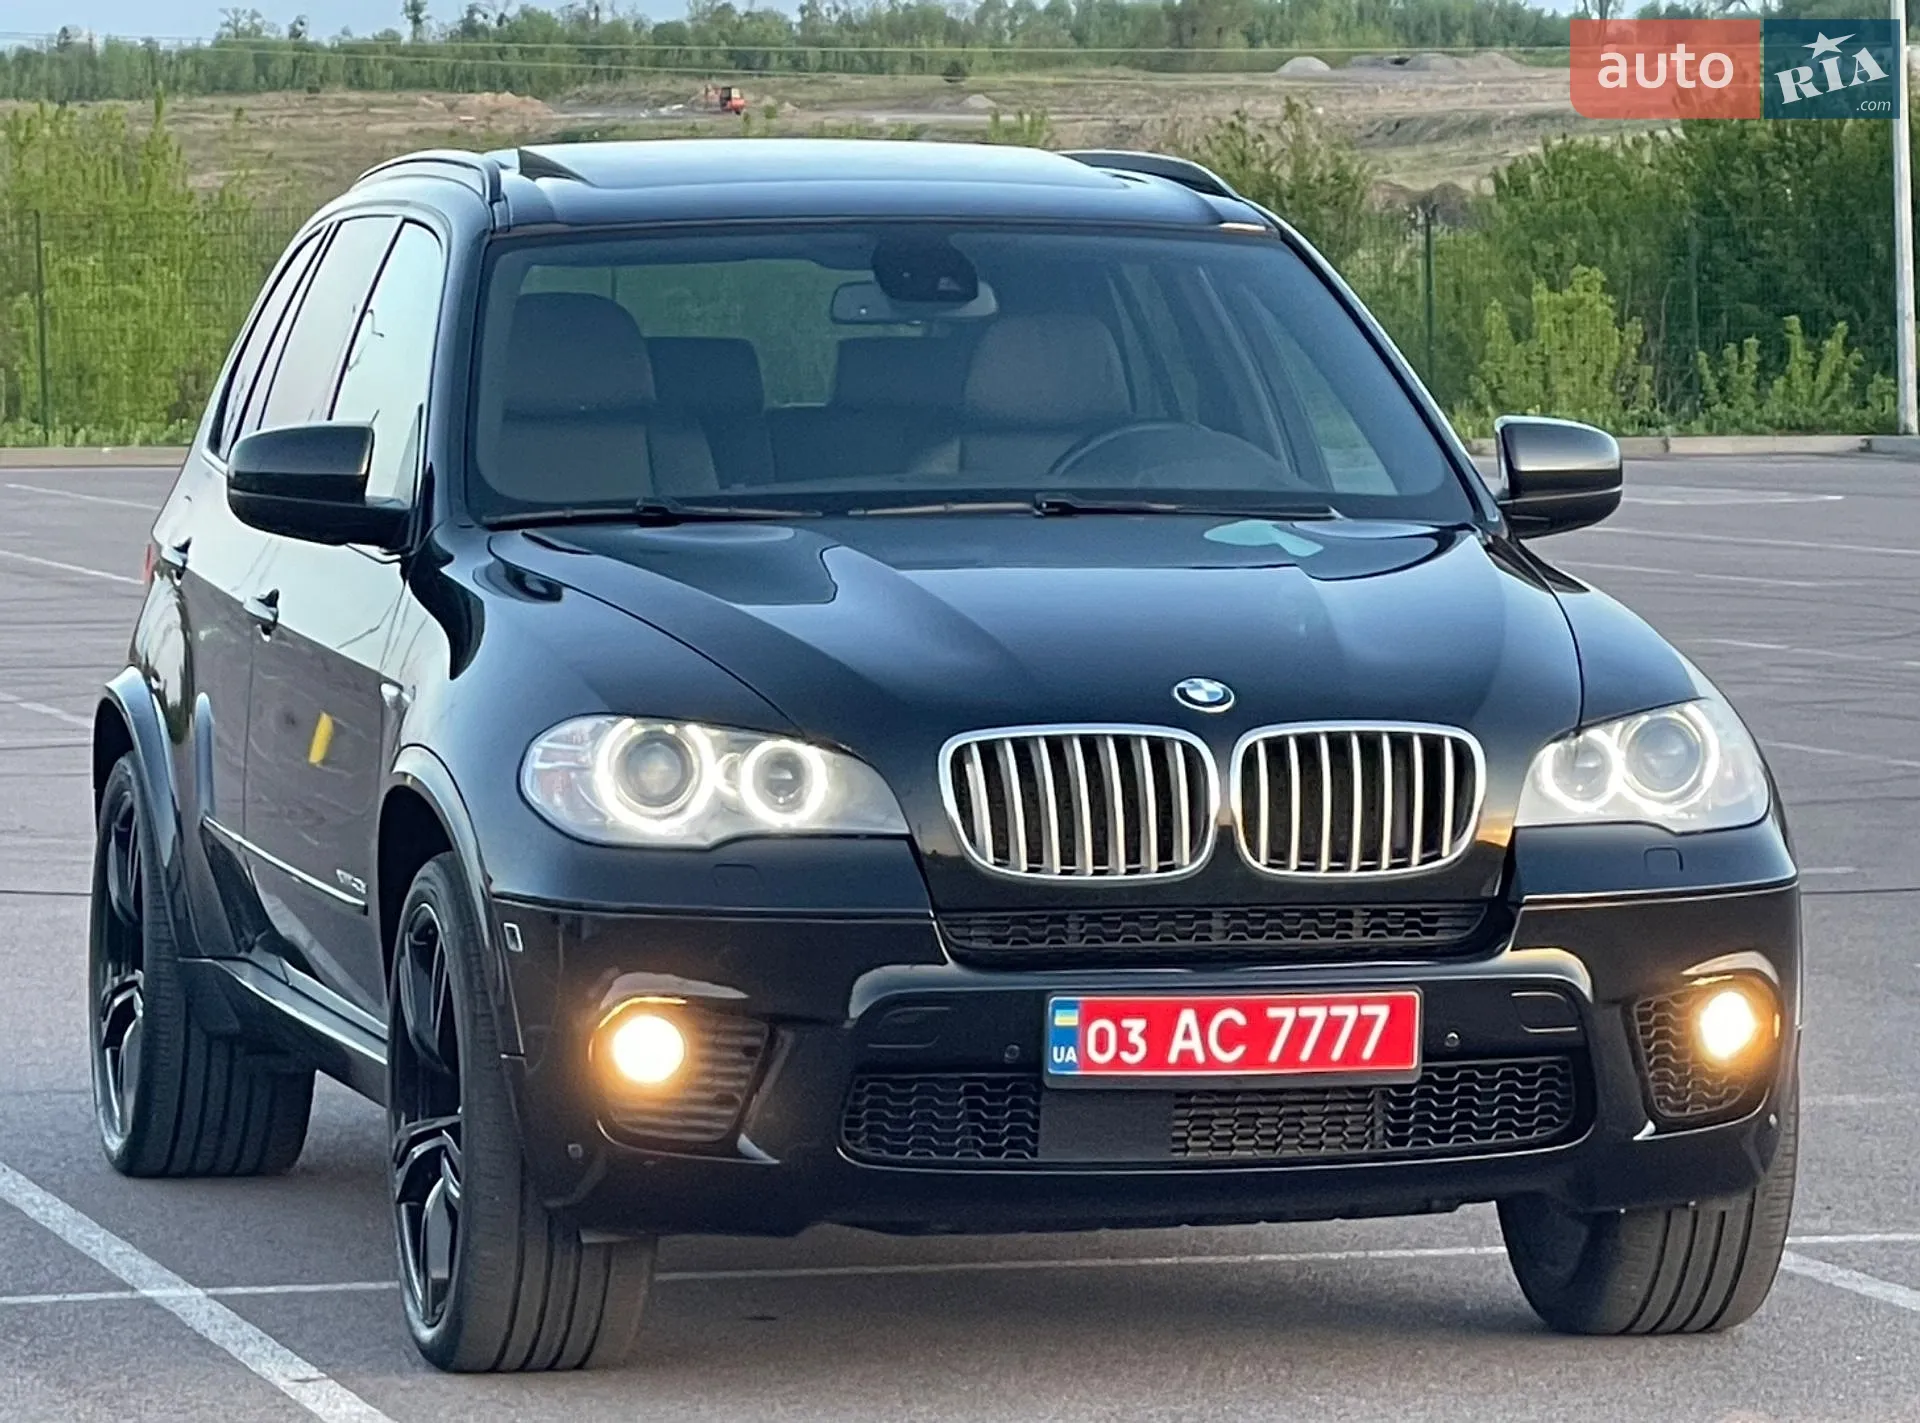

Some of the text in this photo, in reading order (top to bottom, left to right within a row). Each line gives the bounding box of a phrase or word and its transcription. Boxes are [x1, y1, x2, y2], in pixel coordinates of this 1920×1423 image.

[1086, 1004, 1391, 1064] 03 AC 7777
[1052, 1046, 1078, 1064] UA
